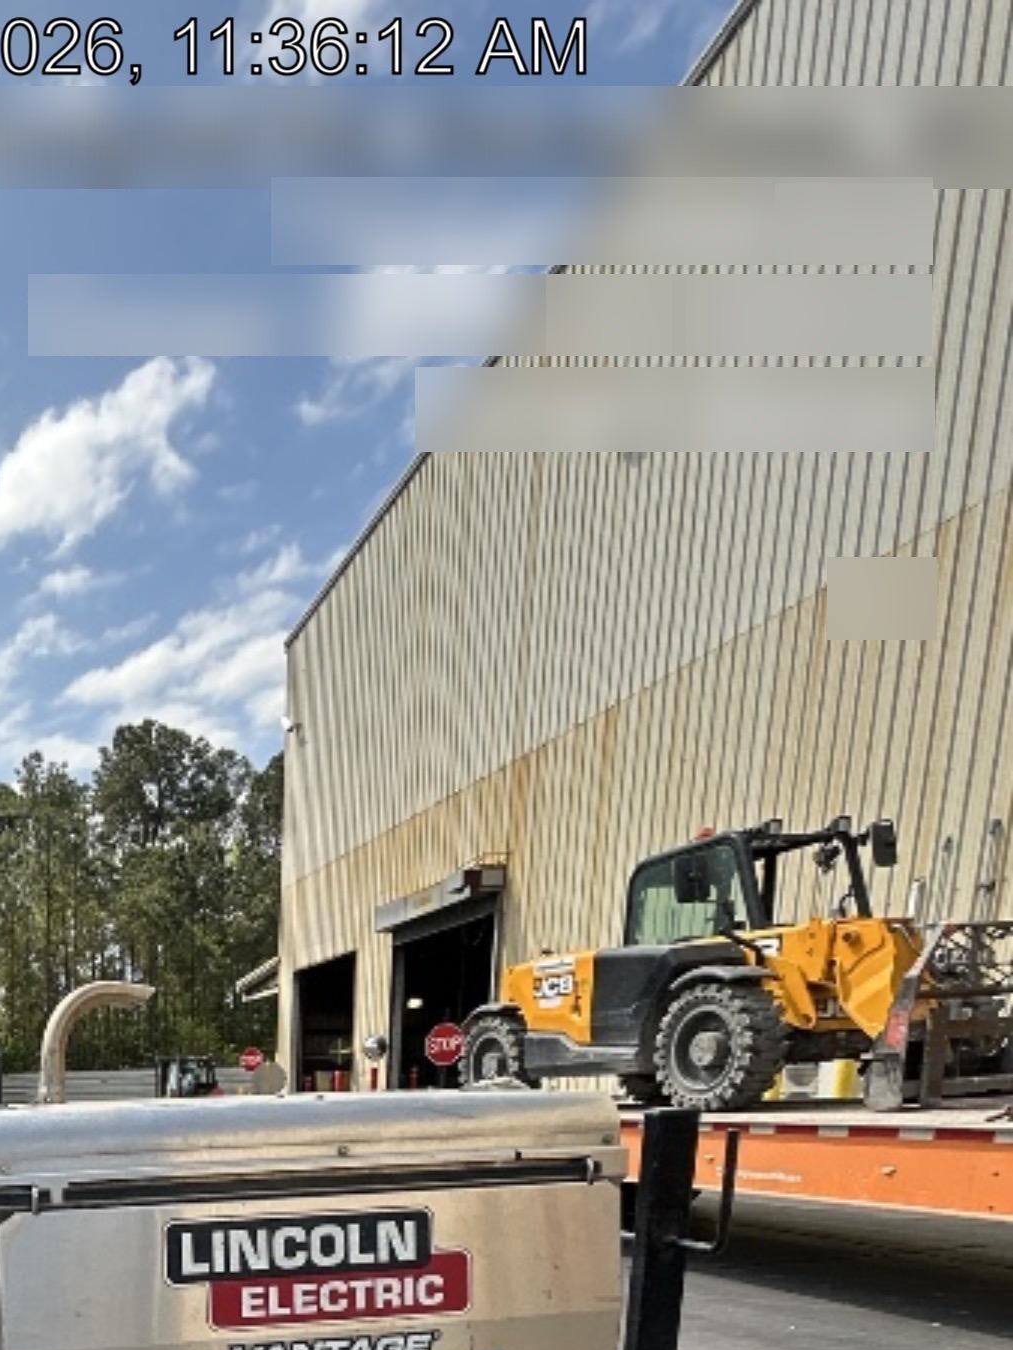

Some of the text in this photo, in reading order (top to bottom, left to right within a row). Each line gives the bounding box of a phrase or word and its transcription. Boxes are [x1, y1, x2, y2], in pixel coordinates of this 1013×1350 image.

[430, 1035, 461, 1054] STOP
[180, 1220, 418, 1277] LINCOLN
[241, 1274, 445, 1319] ELECTRIC
